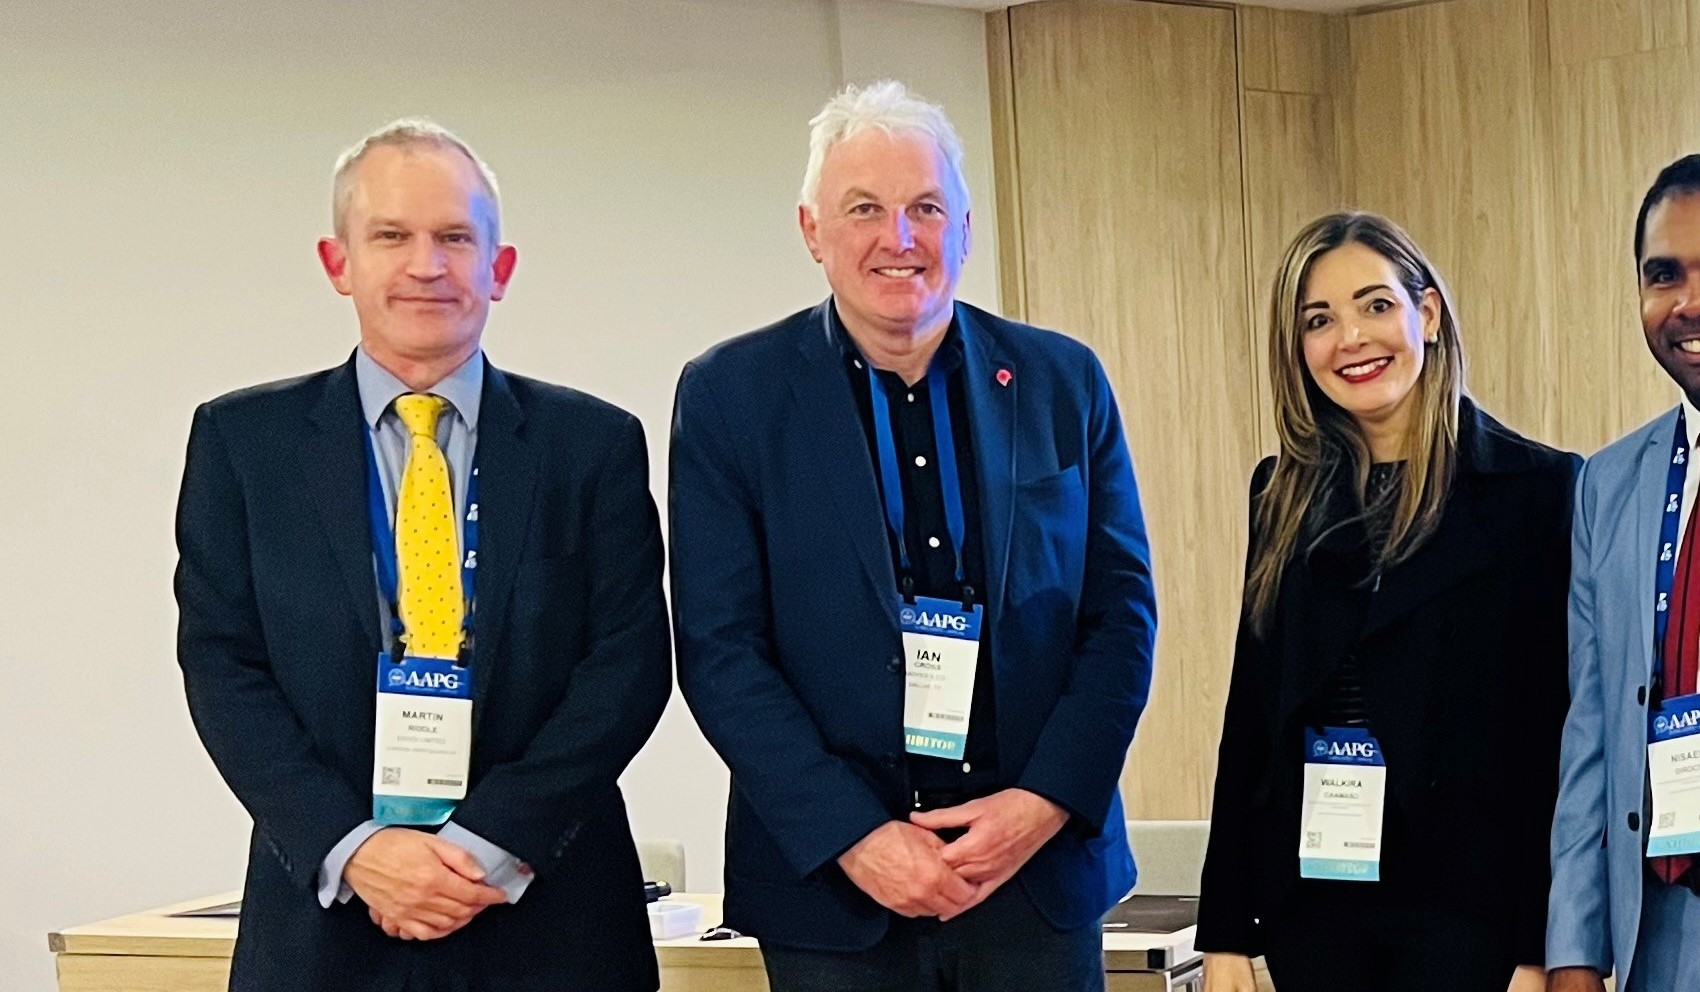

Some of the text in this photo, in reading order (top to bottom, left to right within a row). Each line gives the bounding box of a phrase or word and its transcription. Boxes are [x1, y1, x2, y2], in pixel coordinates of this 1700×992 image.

[916, 611, 966, 631] AAPG
[917, 649, 941, 662] IAN
[405, 670, 459, 689] AAPG
[402, 710, 443, 721] MARTIN
[1328, 741, 1373, 757] AAPG
